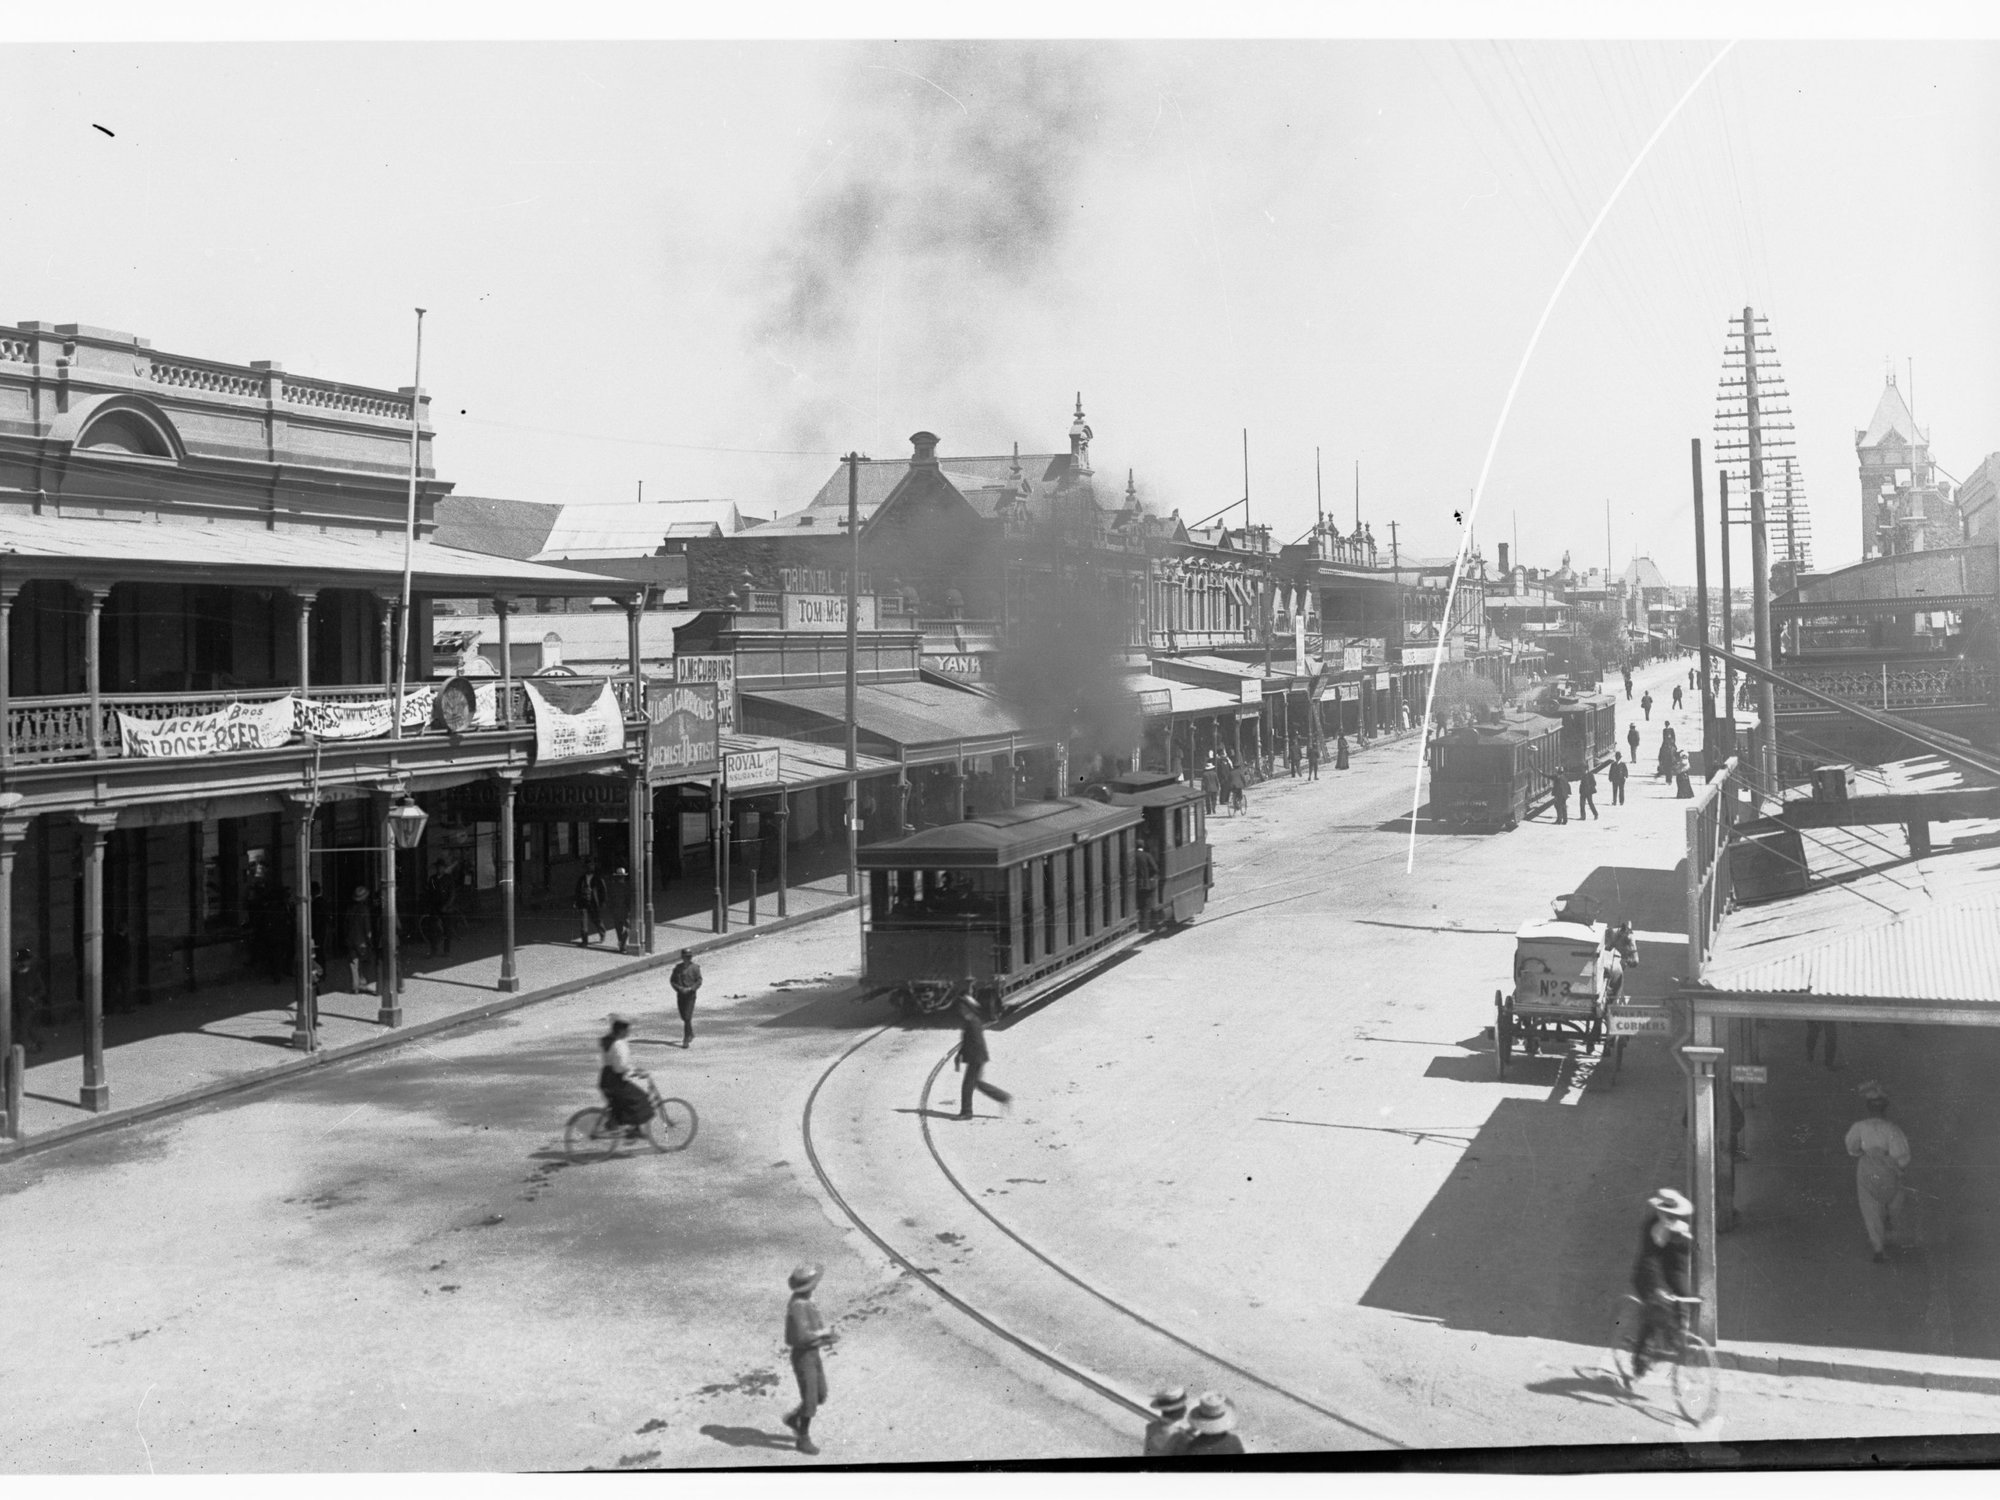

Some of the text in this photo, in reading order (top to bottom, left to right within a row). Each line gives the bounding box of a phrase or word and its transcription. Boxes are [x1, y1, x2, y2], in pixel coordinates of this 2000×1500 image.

[840, 571, 875, 594] HTEL
[798, 599, 822, 623] TOM
[152, 718, 218, 737] JACKA
[214, 722, 263, 751] BEER
[727, 753, 764, 773] ROYAL
[1560, 980, 1571, 996] 3
[1616, 1021, 1666, 1031] CORNERS
